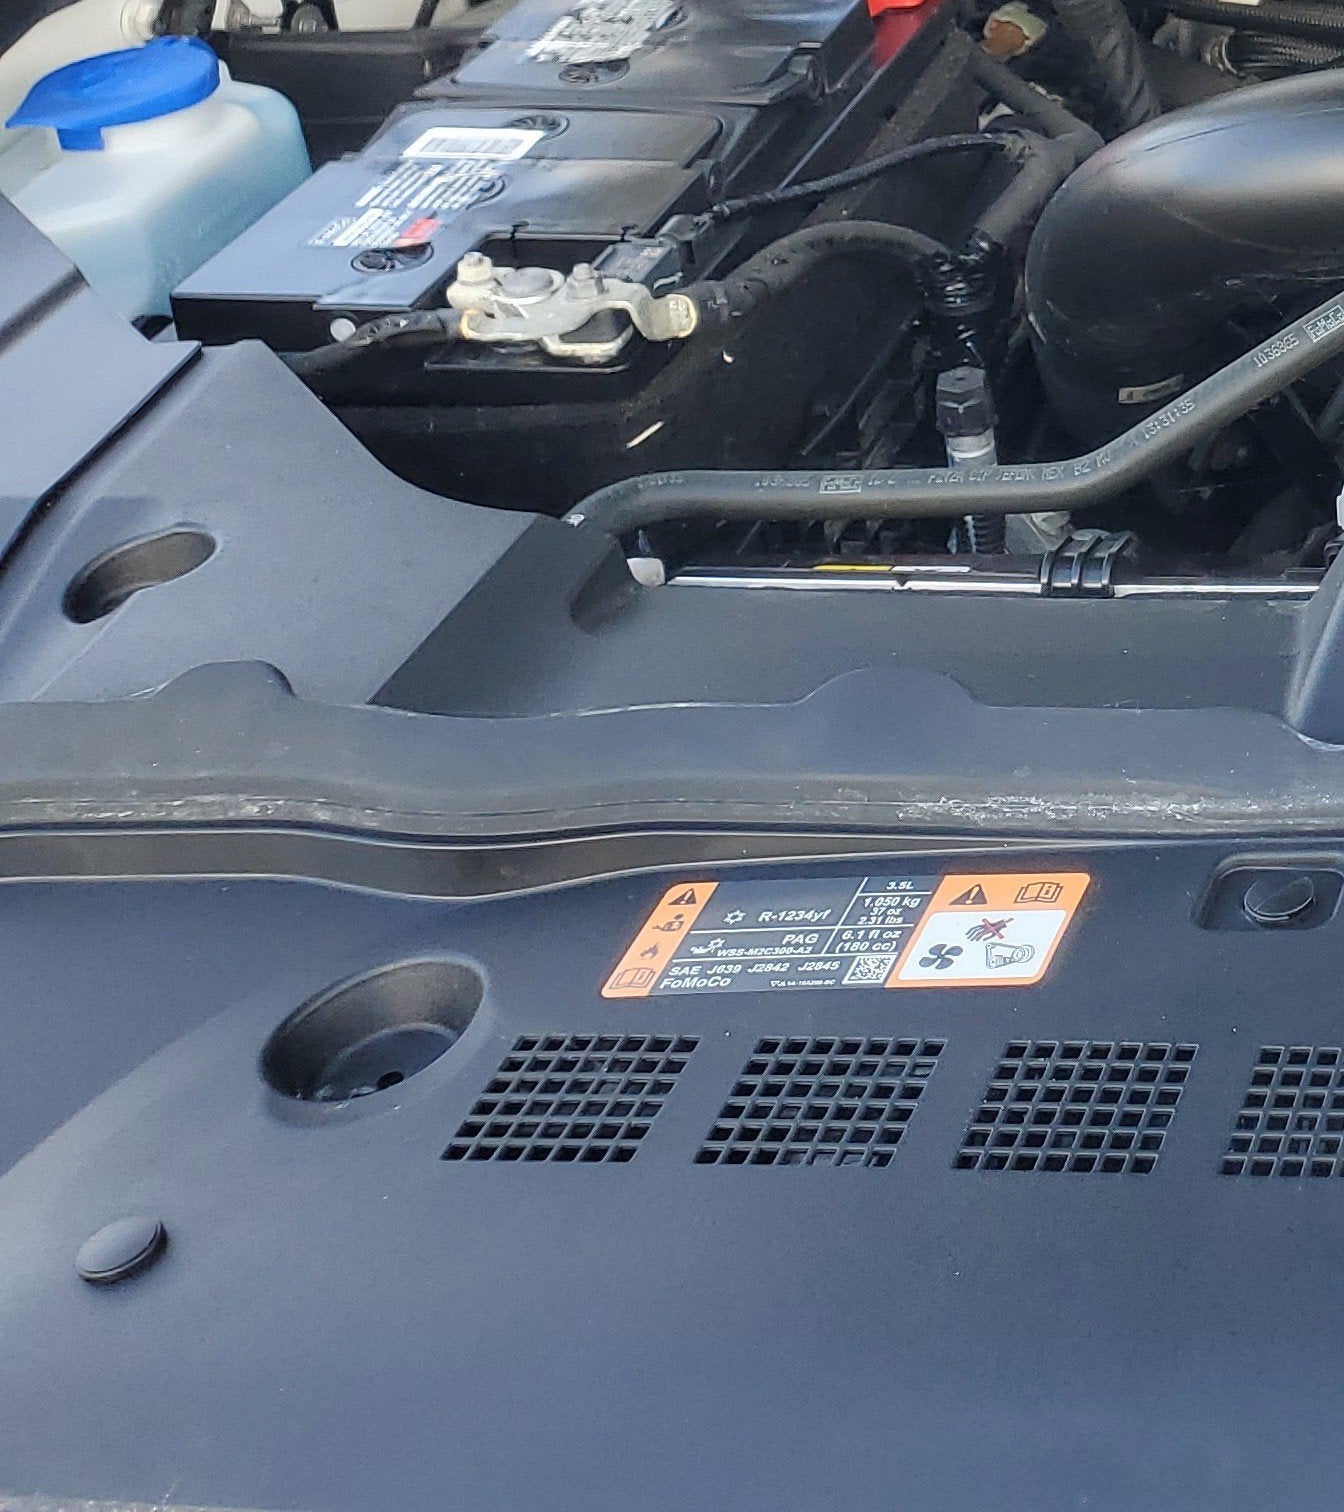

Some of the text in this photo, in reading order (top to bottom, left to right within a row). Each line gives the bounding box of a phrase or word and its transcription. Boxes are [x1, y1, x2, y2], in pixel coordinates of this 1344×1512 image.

[886, 880, 915, 891] 3.5L
[863, 896, 922, 909] 1.050 kg
[758, 908, 832, 923] R-1234yf
[870, 907, 903, 916] 37 oz
[857, 915, 904, 925] 2.31 lbs
[781, 933, 820, 946] PAG
[841, 929, 903, 941] 6.1 fl oz
[835, 940, 898, 954] (180 cc)
[668, 960, 841, 976] SAE J639 J2842 J2845
[659, 976, 732, 990] FoMoCo
